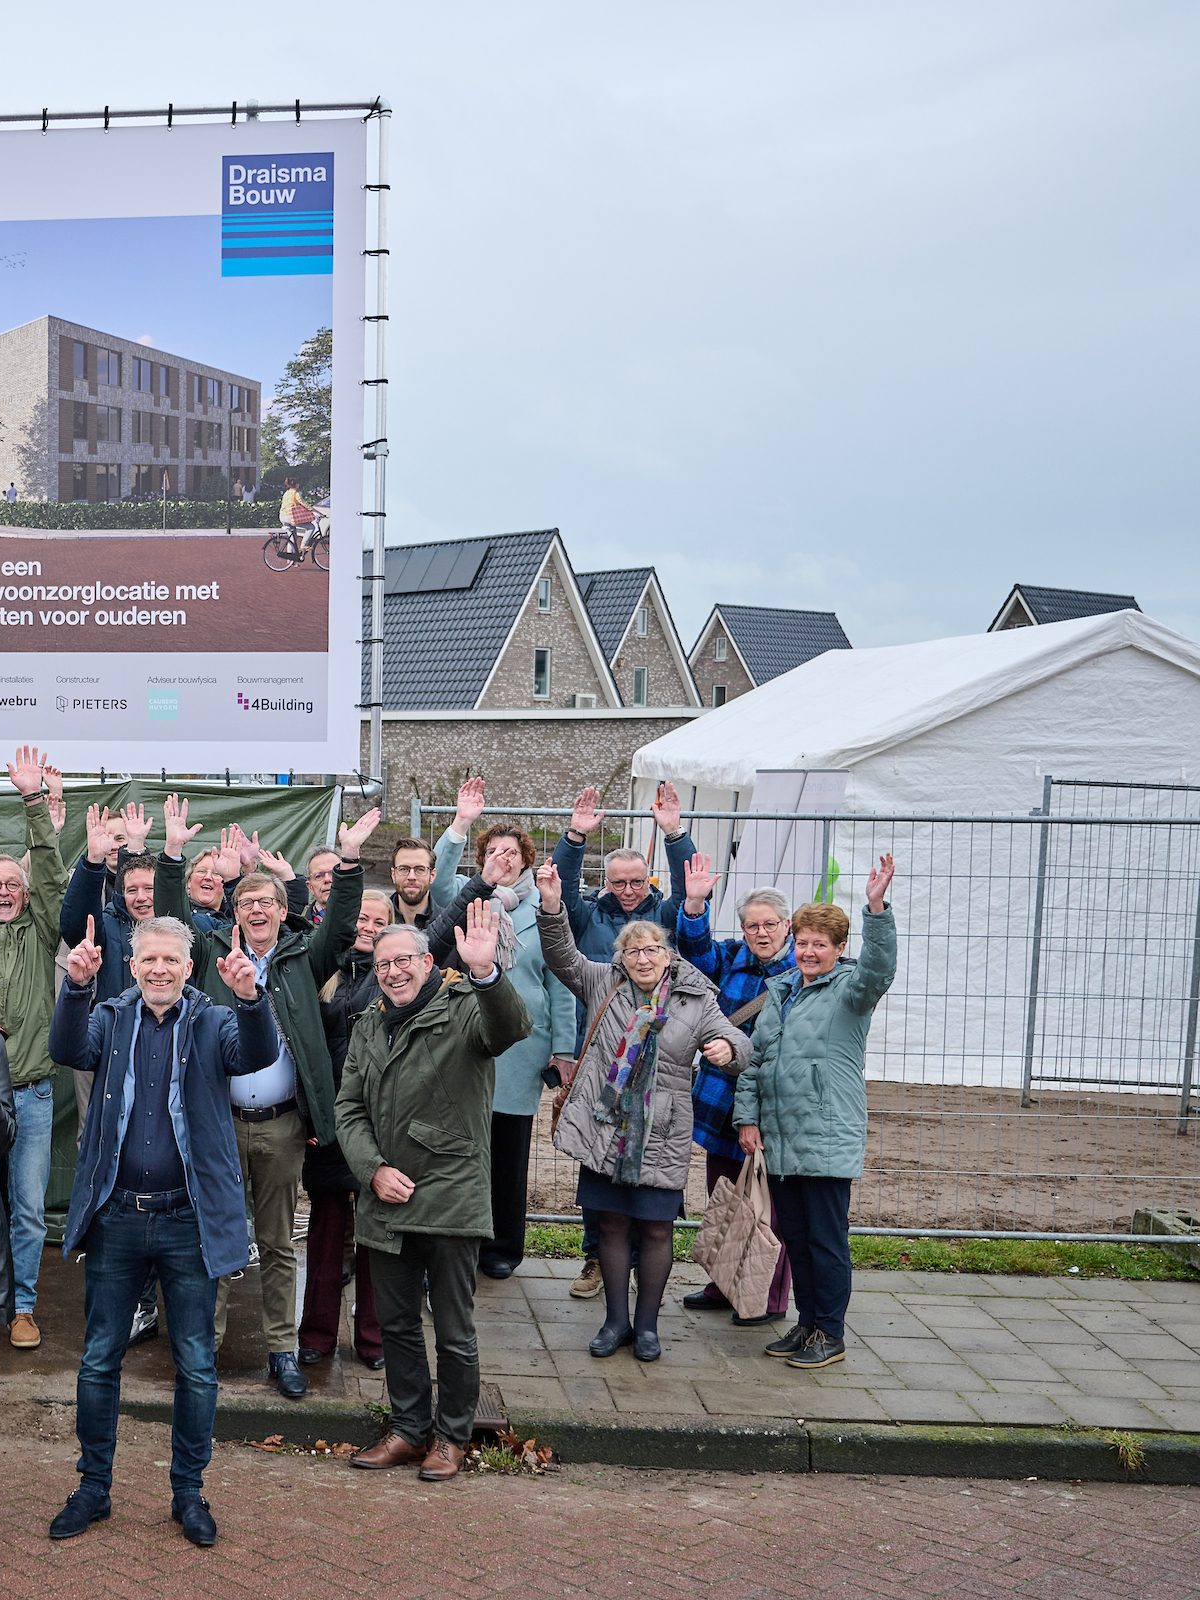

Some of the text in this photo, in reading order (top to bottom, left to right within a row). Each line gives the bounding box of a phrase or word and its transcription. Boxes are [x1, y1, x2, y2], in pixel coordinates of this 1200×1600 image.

[229, 163, 327, 185] Draisma
[229, 185, 296, 206] Bouw
[0, 560, 42, 576] een
[175, 581, 220, 600] met
[38, 609, 90, 626] voor
[94, 605, 187, 626] ouderen
[0, 675, 34, 684] installaties
[55, 675, 101, 684] Constructeur
[147, 676, 217, 685] Adviseur bouwfysica
[237, 676, 304, 685] Bouwmanagement
[73, 699, 128, 710] PIETERS
[251, 698, 313, 713] 4Building
